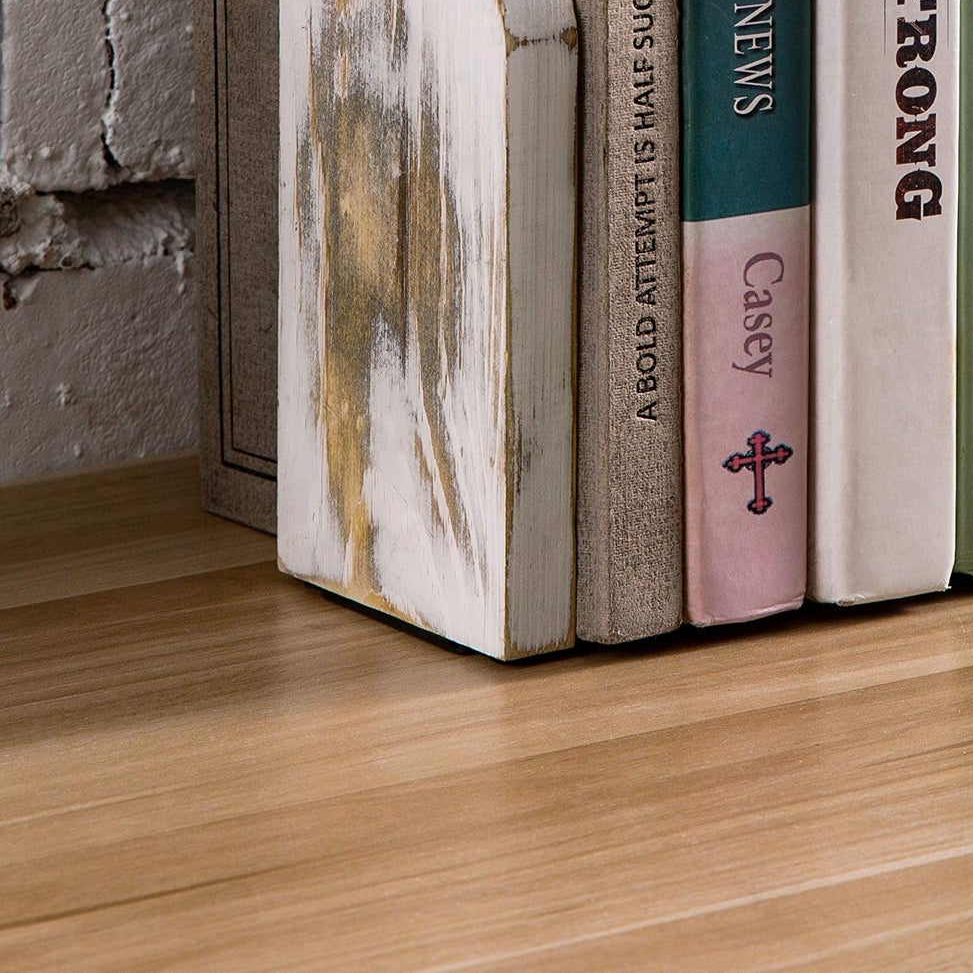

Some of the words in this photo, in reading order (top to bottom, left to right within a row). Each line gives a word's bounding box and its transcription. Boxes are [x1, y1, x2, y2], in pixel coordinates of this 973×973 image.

[633, 59, 656, 130] HALF
[634, 139, 656, 165] IS
[634, 173, 657, 305] ATTEMPT
[732, 251, 784, 378] Casey
[636, 316, 657, 395] BOLD
[636, 400, 657, 421] A
